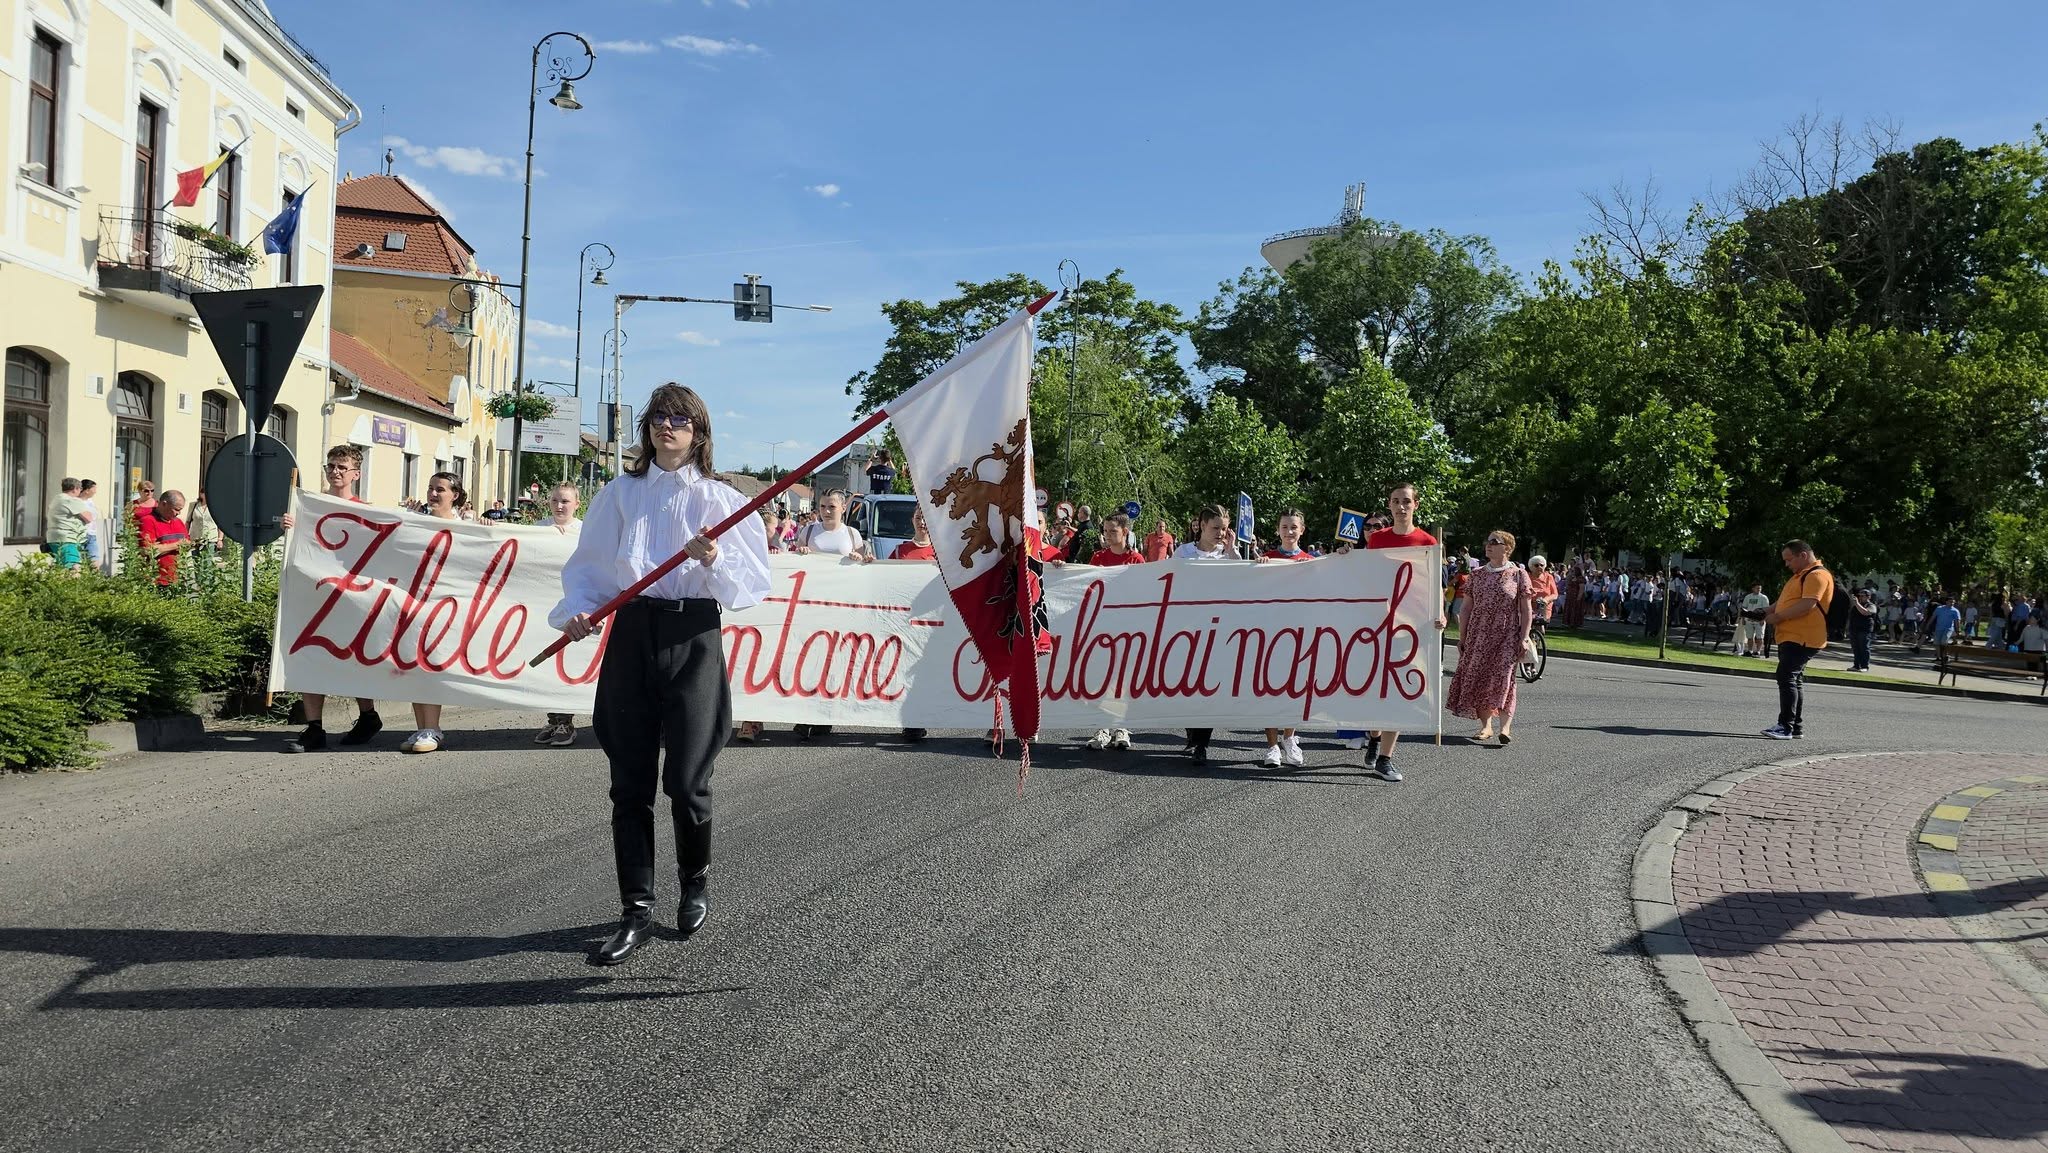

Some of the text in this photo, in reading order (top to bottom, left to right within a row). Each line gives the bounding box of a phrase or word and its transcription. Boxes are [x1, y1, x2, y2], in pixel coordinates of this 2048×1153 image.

[289, 512, 528, 680] Zilele
[555, 570, 911, 702] ntane
[952, 573, 1222, 702] lontai
[1226, 561, 1426, 721] napok
